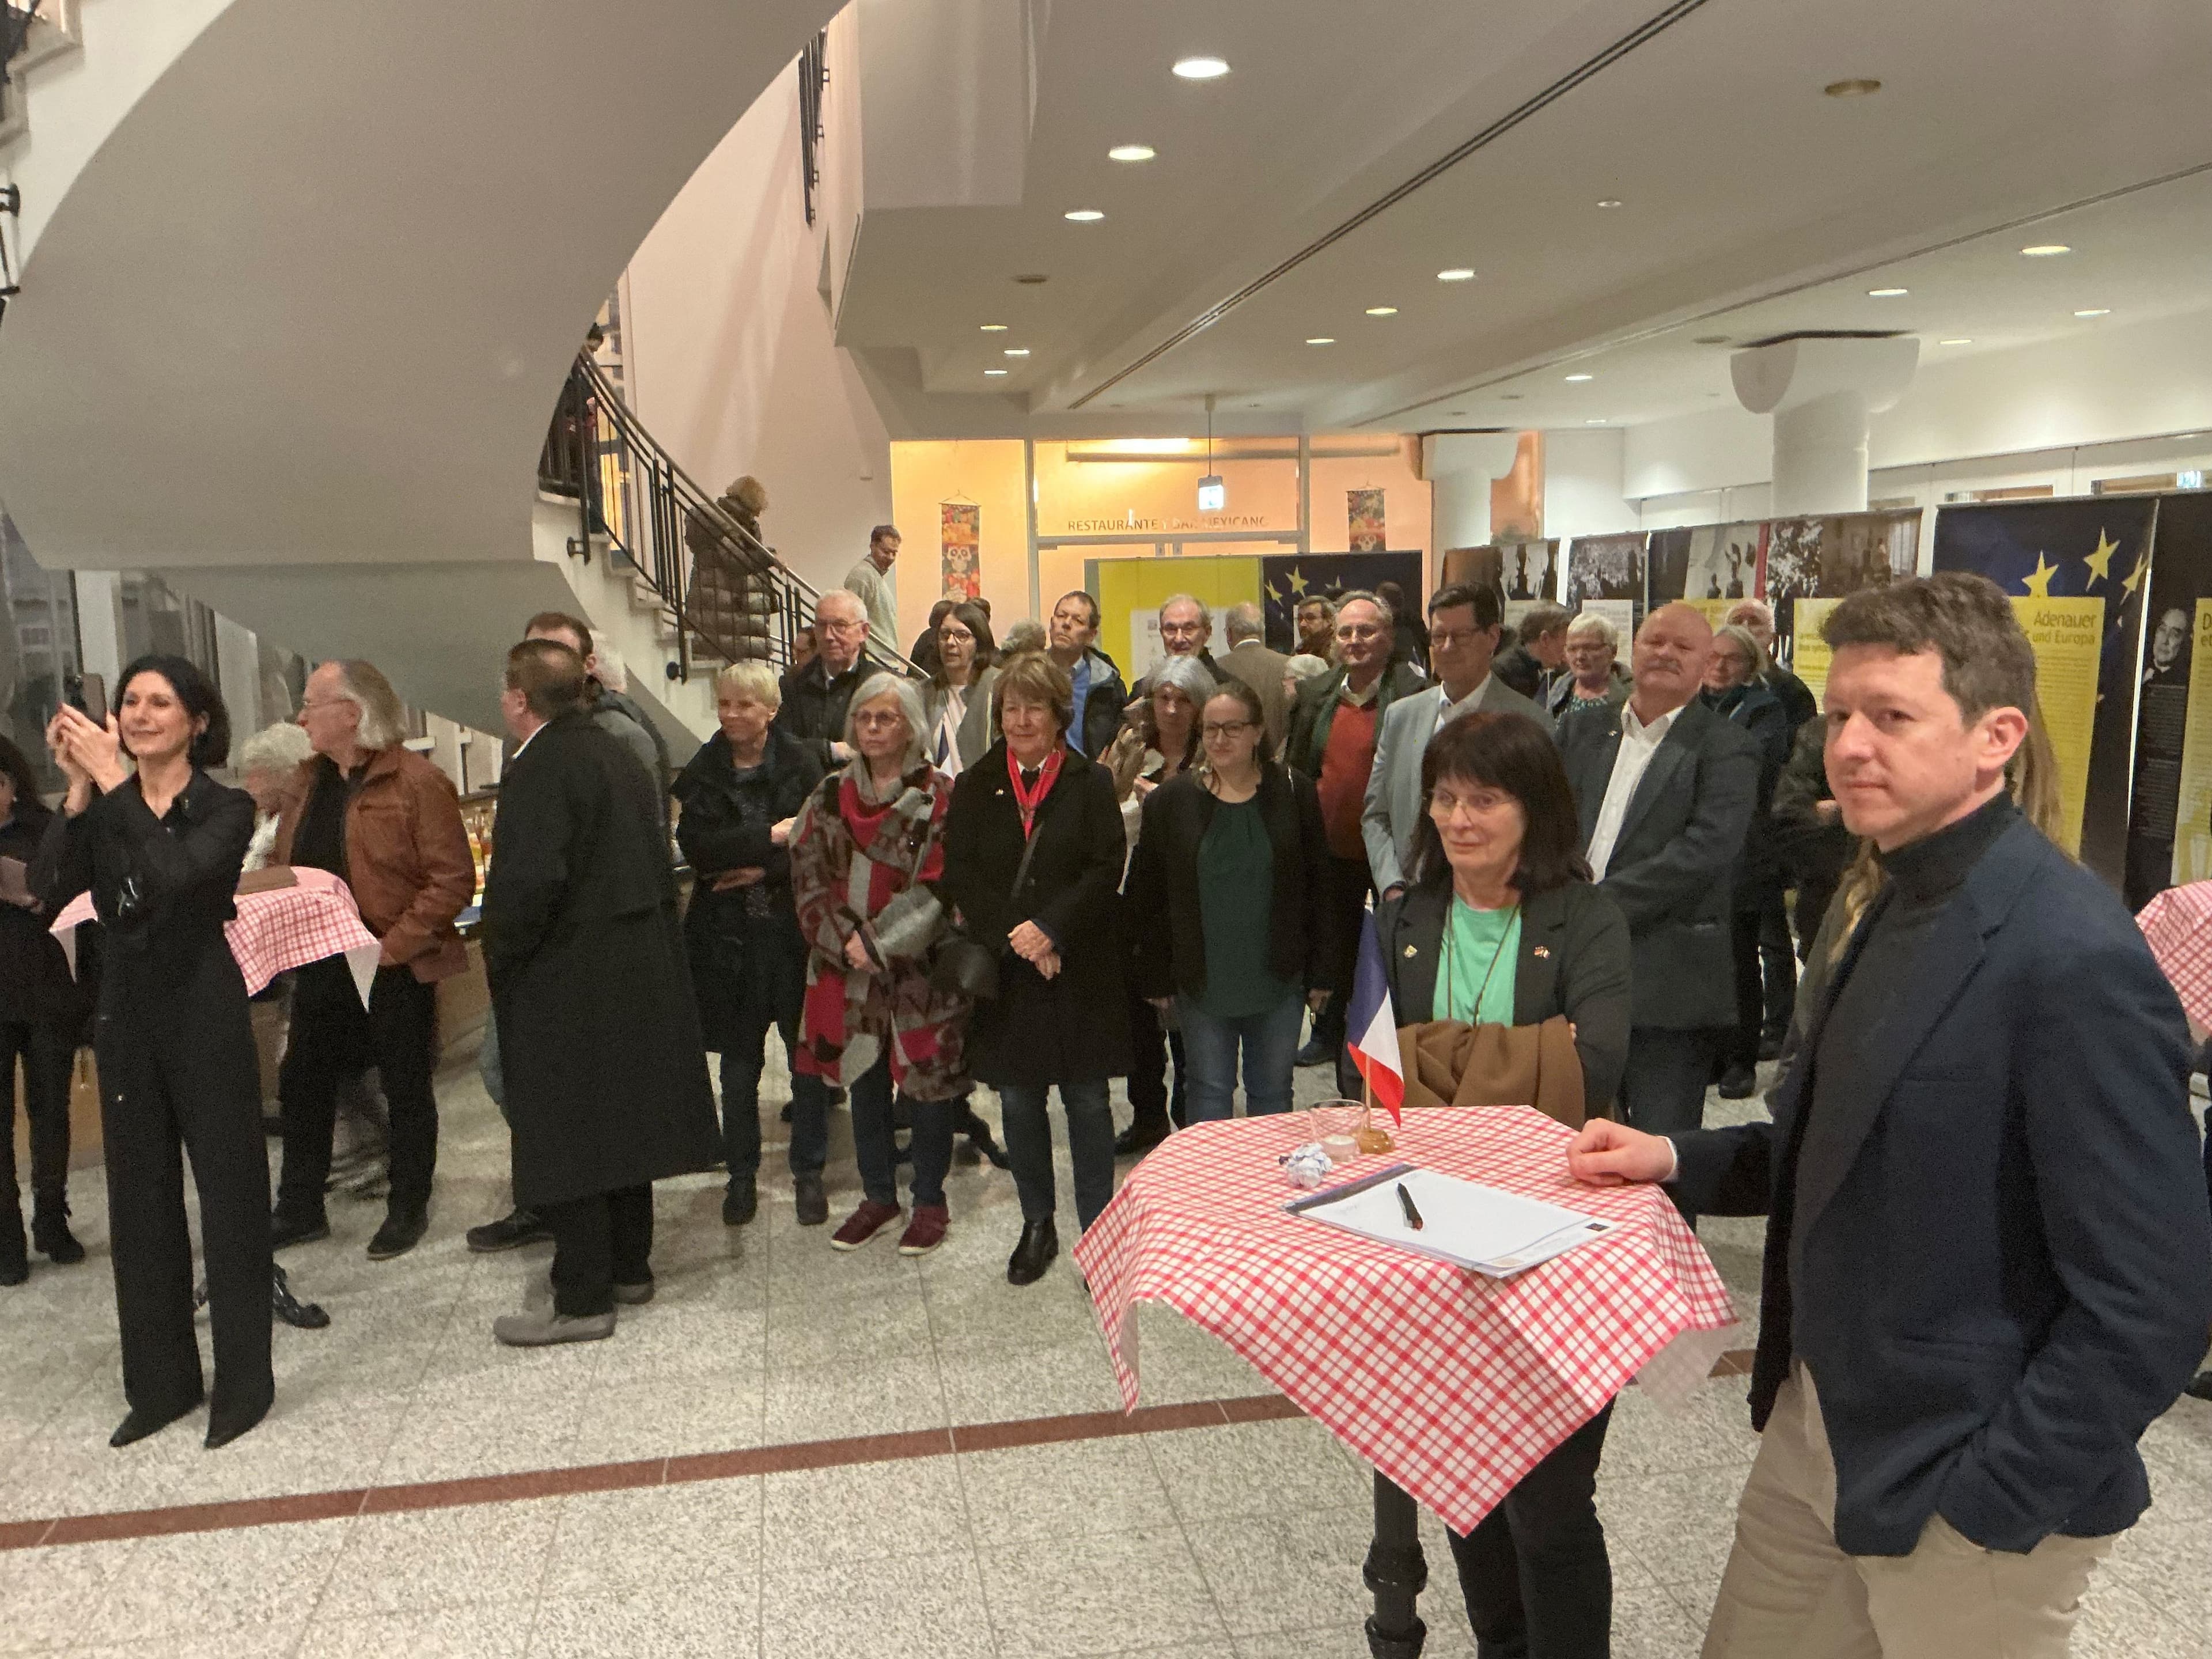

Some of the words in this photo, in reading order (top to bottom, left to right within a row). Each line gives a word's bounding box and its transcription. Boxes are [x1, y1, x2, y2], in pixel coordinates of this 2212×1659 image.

[1068, 519, 1158, 531] RESTAURANTE
[2033, 609, 2097, 628] Adenauer
[2032, 631, 2051, 643] und
[2054, 631, 2096, 646] Europa
